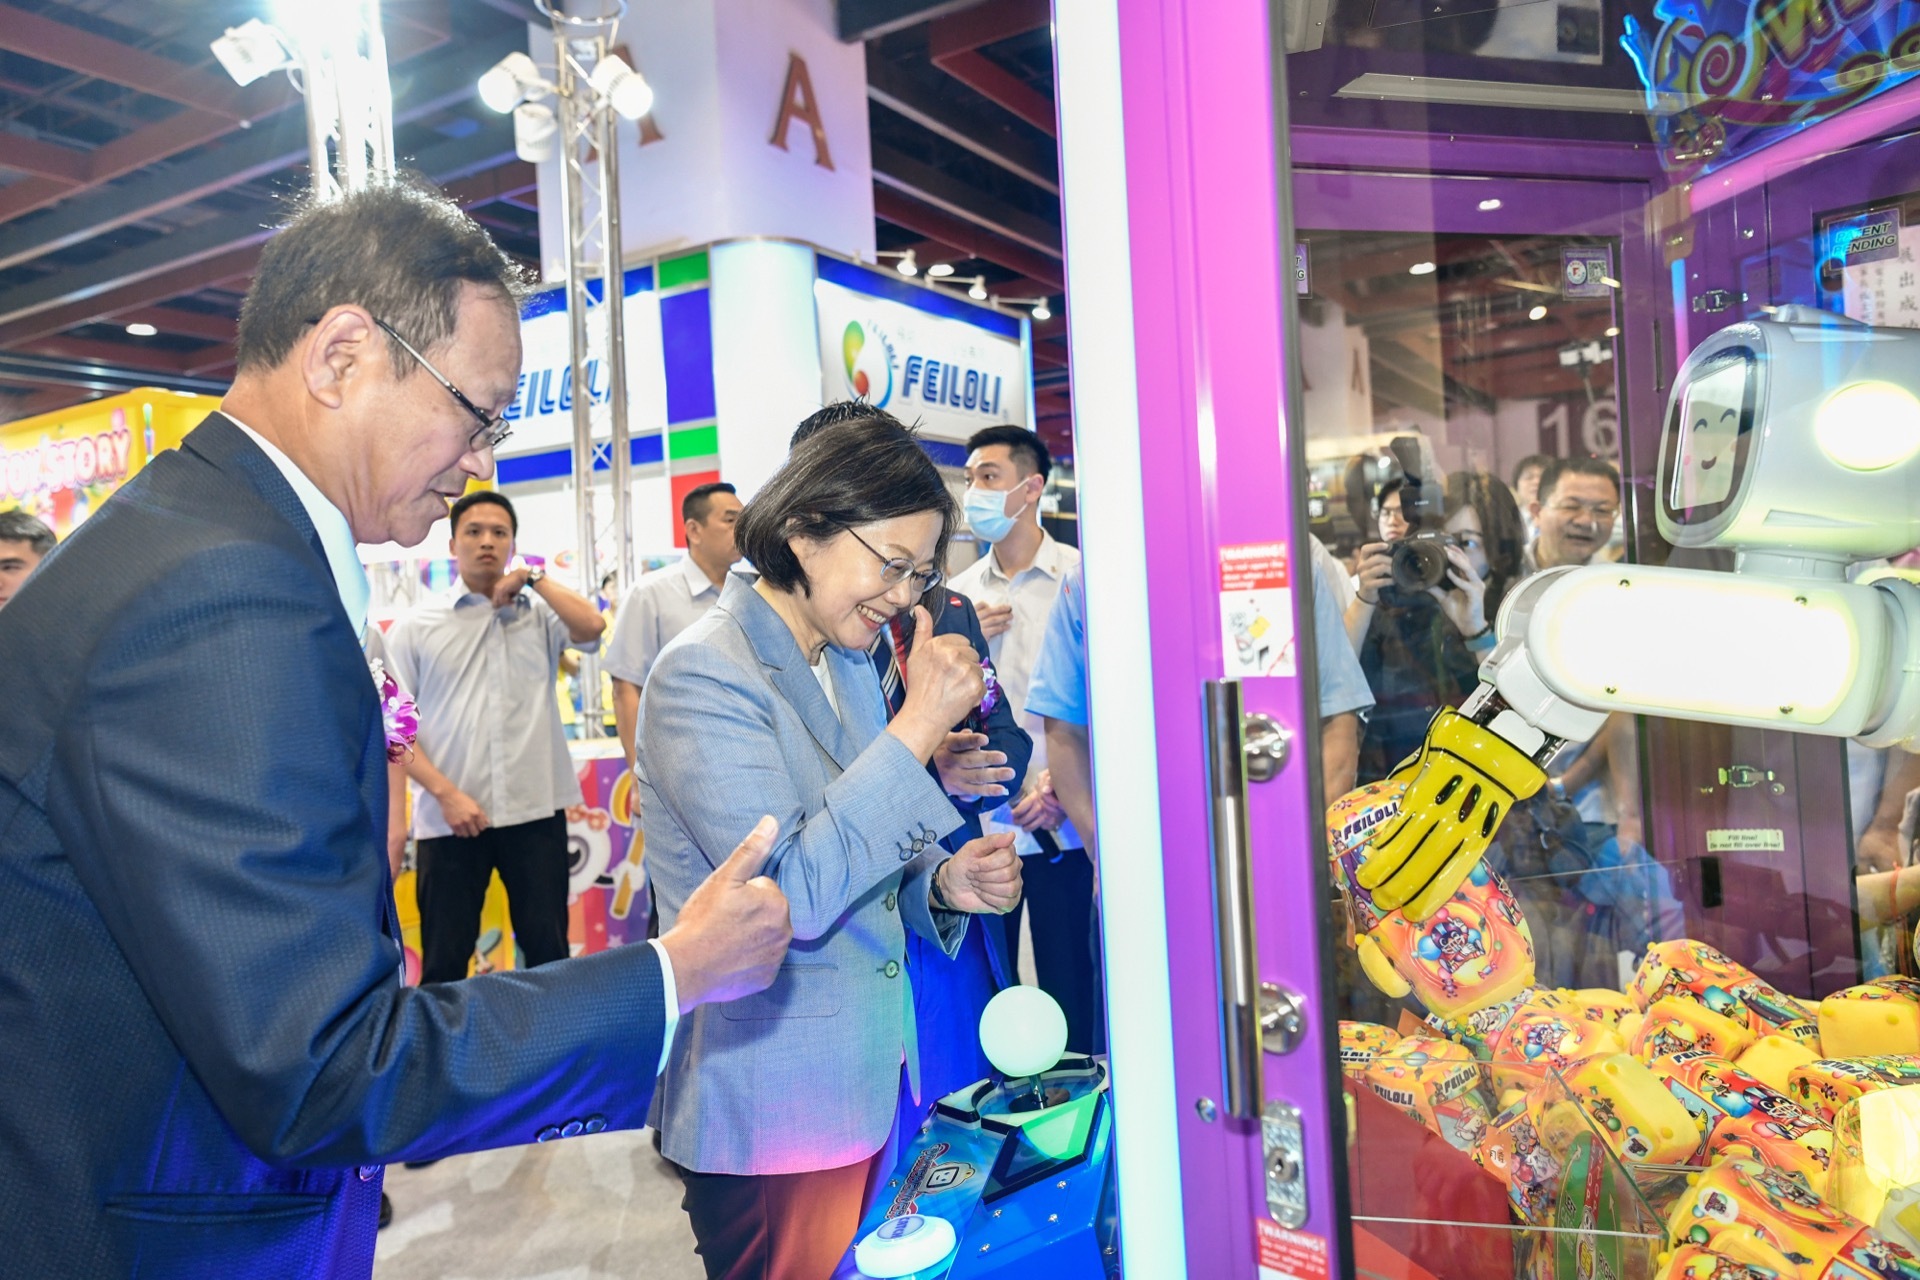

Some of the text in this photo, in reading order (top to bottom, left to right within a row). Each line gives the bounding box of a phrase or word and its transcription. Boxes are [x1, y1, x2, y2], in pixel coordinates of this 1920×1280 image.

[769, 52, 836, 172] A
[1832, 235, 1896, 257] PENDING
[1836, 221, 1892, 243] PATENT
[902, 354, 1003, 416] FEILOLI
[48, 428, 130, 492] STORY
[1343, 801, 1399, 841] FEILOLI
[1374, 1084, 1414, 1105] FEILOLI
[1443, 1065, 1478, 1094] FEILOLI
